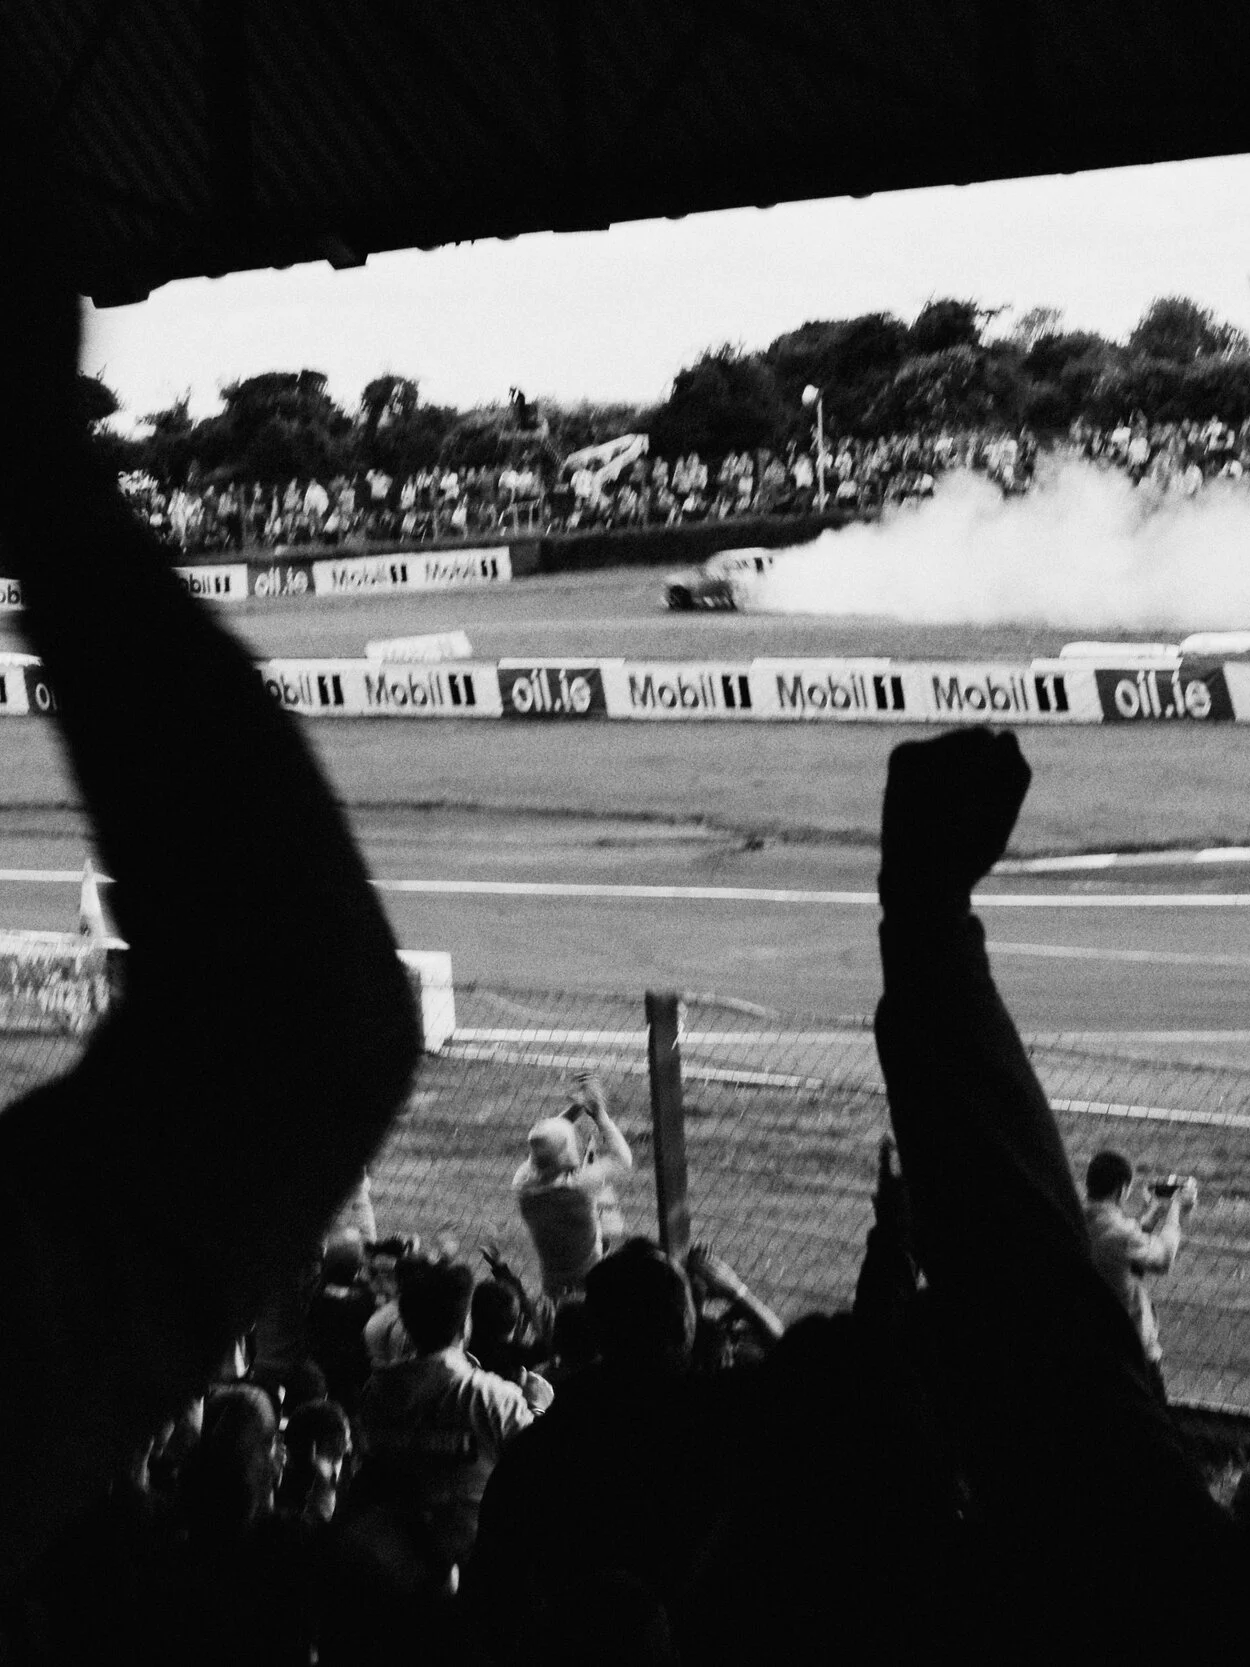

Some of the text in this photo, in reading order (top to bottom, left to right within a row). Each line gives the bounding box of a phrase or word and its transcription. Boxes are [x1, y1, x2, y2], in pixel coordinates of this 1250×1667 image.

[265, 673, 313, 706] obil
[364, 673, 444, 706] Mobil
[511, 668, 592, 713] oil.ie
[629, 673, 716, 708] Mobil
[776, 674, 868, 710] Mobil
[932, 675, 1029, 711] Mobil
[1115, 669, 1212, 718] oil.ie
